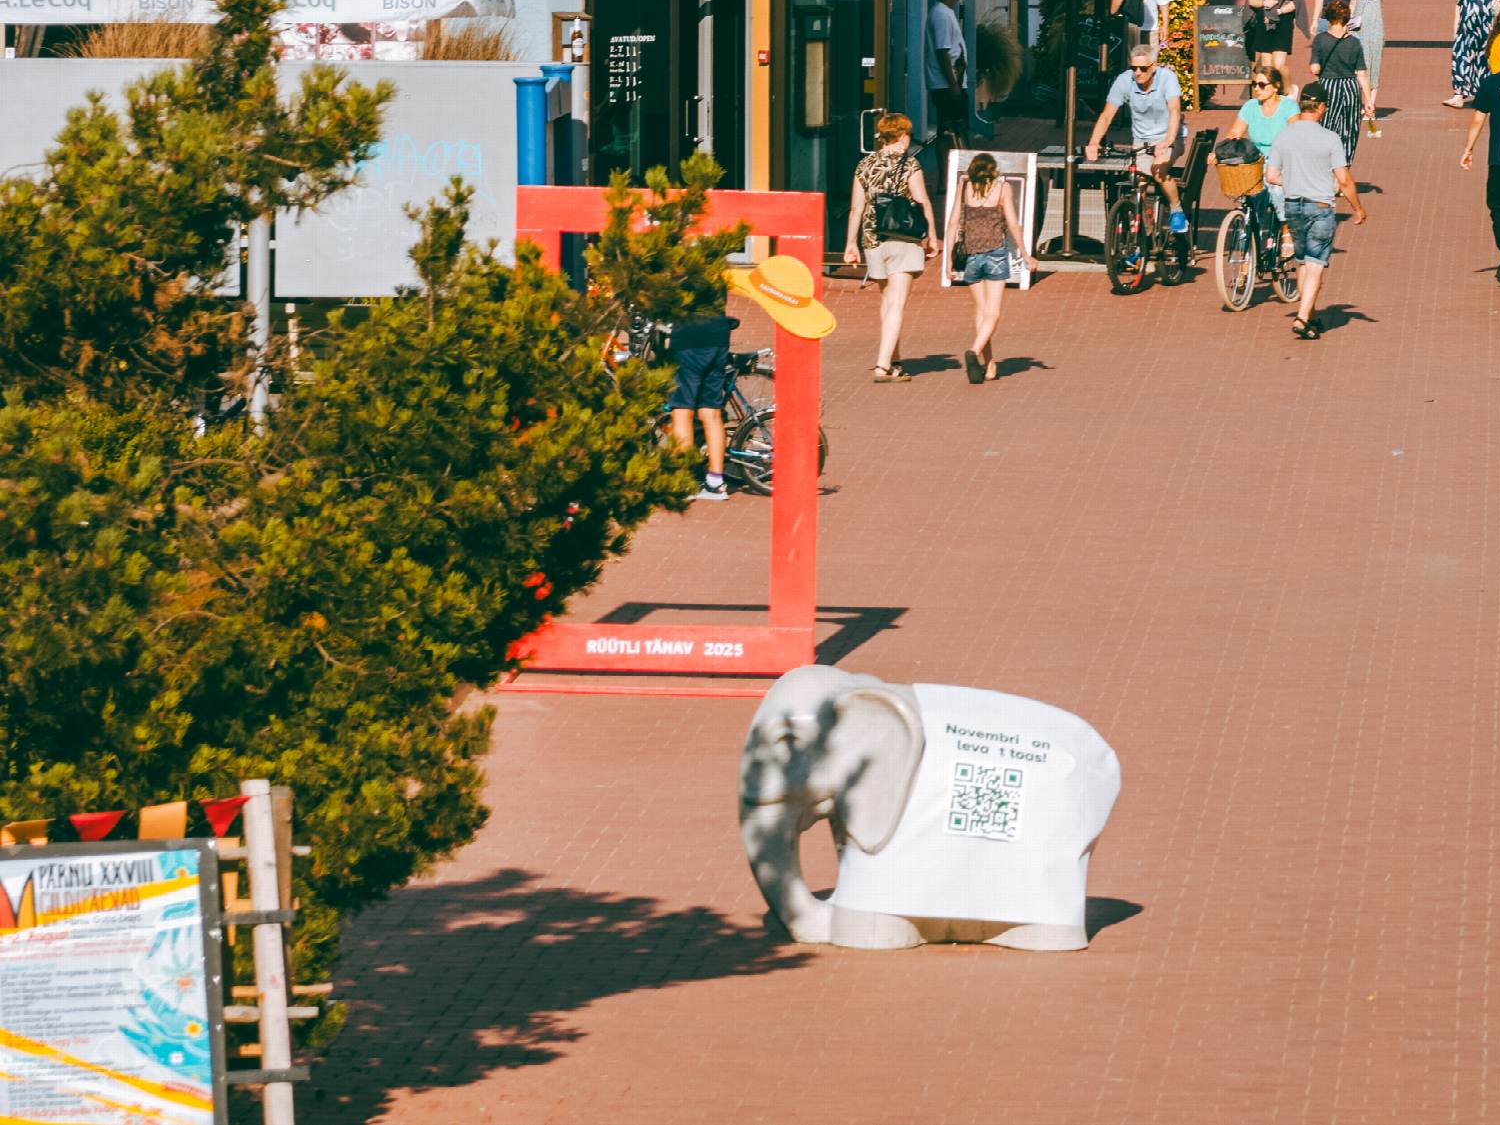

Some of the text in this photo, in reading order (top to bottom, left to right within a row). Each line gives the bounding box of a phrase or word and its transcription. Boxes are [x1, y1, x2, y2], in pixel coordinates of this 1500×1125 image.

[586, 639, 744, 657] RÜÜTLI TÄNAV 2025
[945, 724, 1051, 750] Novembri on
